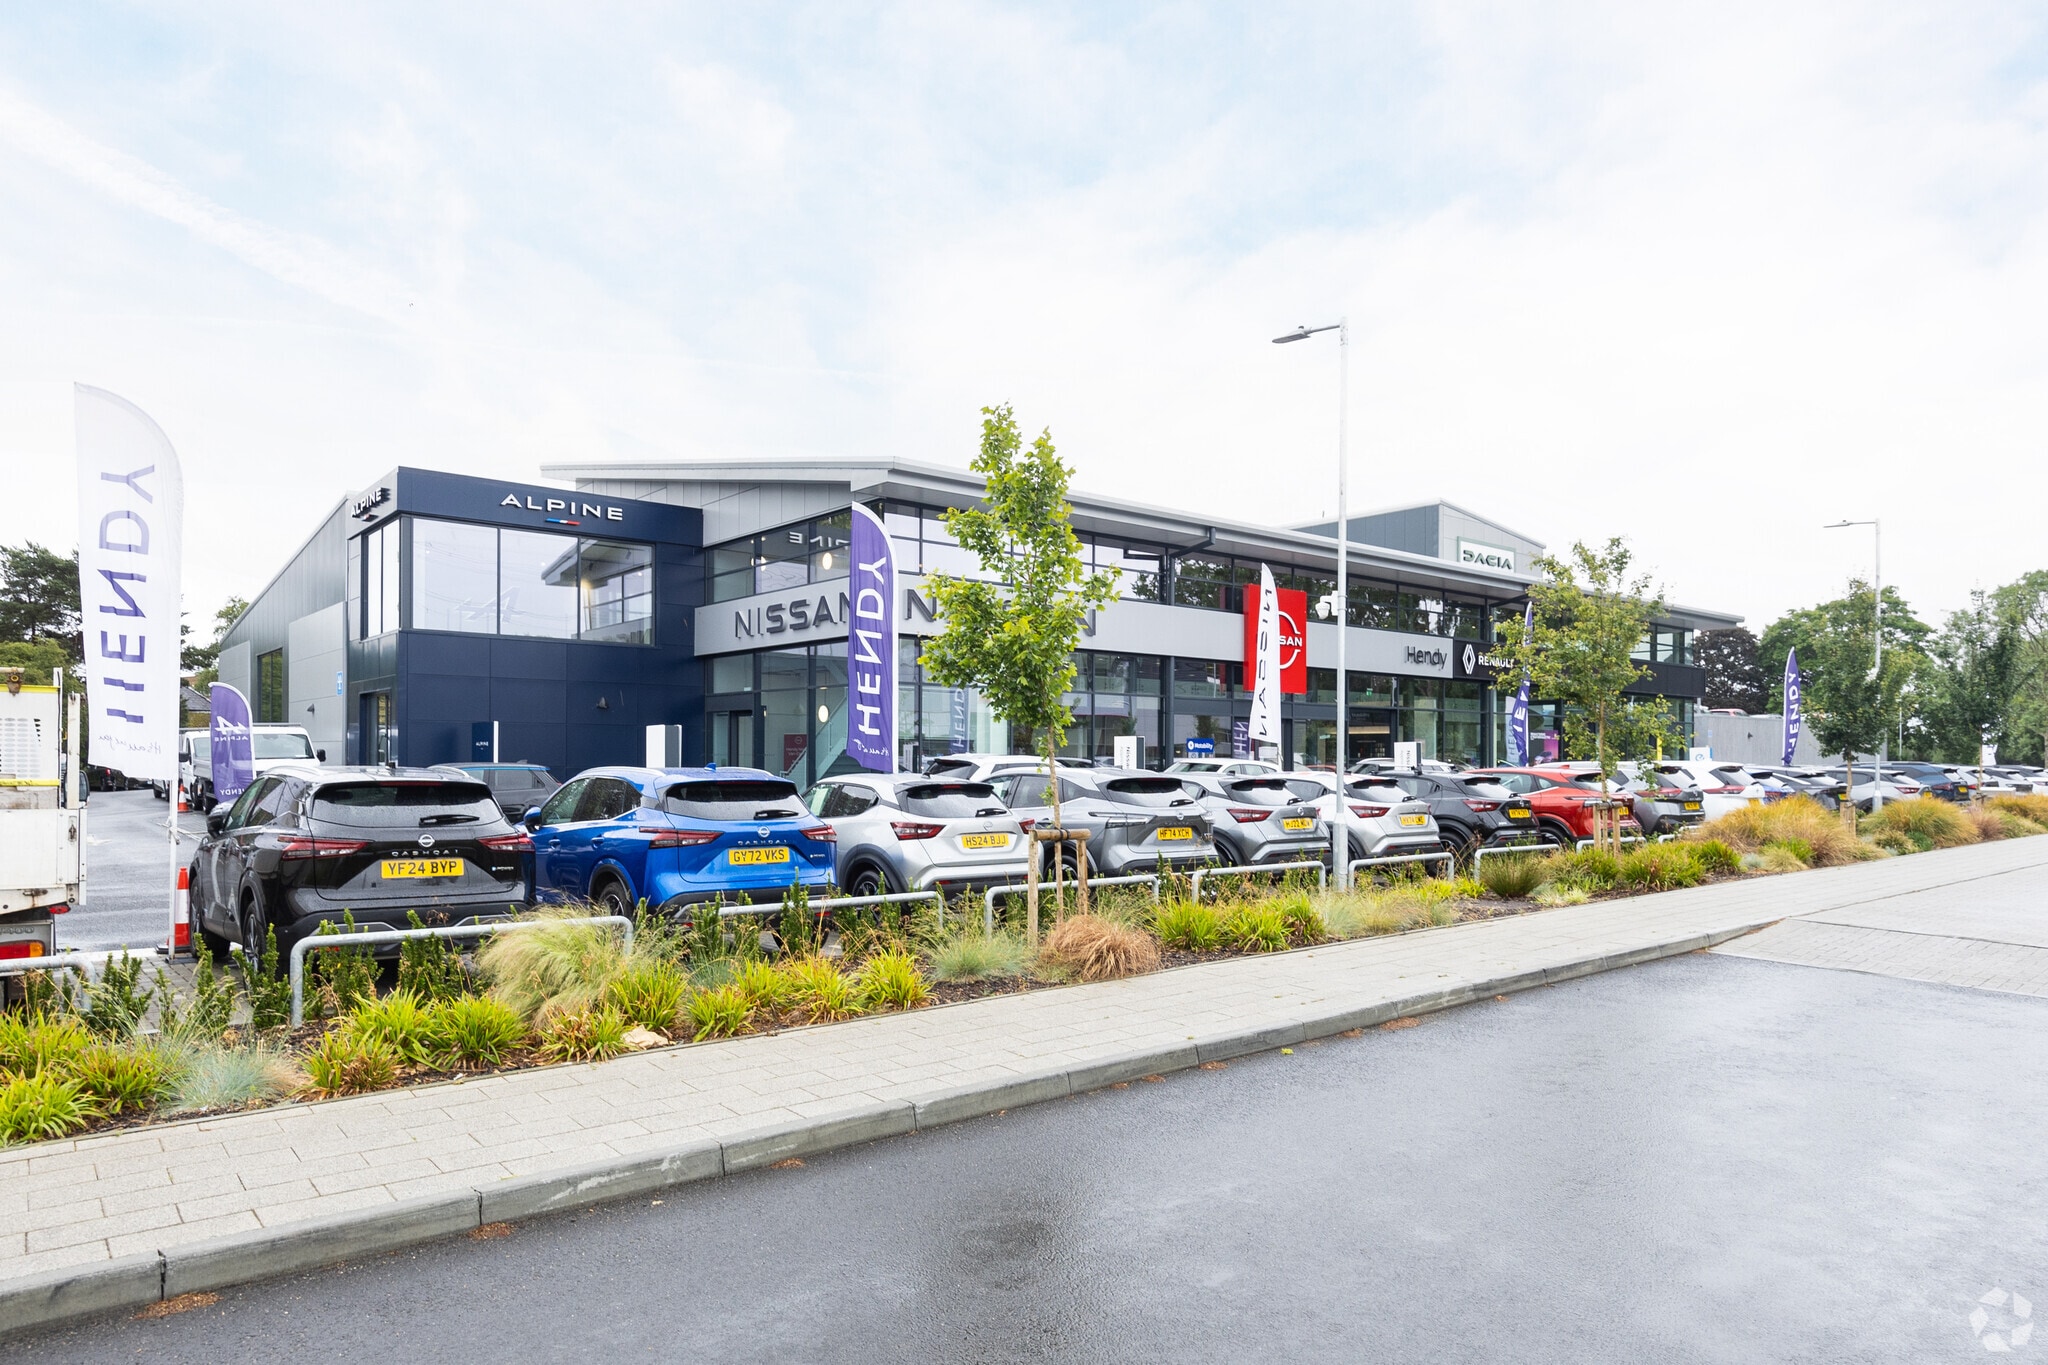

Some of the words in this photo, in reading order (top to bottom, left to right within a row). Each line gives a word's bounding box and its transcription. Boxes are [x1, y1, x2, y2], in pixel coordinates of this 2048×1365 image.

[351, 487, 385, 518] ALPINE
[500, 493, 624, 521] ALPINE
[1462, 549, 1513, 570] DACIA
[1280, 635, 1303, 648] SAN
[1405, 645, 1448, 670] Hendy
[966, 836, 988, 846] HS24
[990, 835, 1007, 845] BJJ
[733, 850, 761, 862] GY72
[764, 849, 785, 860] VKS
[388, 861, 426, 875] YF24
[430, 860, 458, 874] BYP
